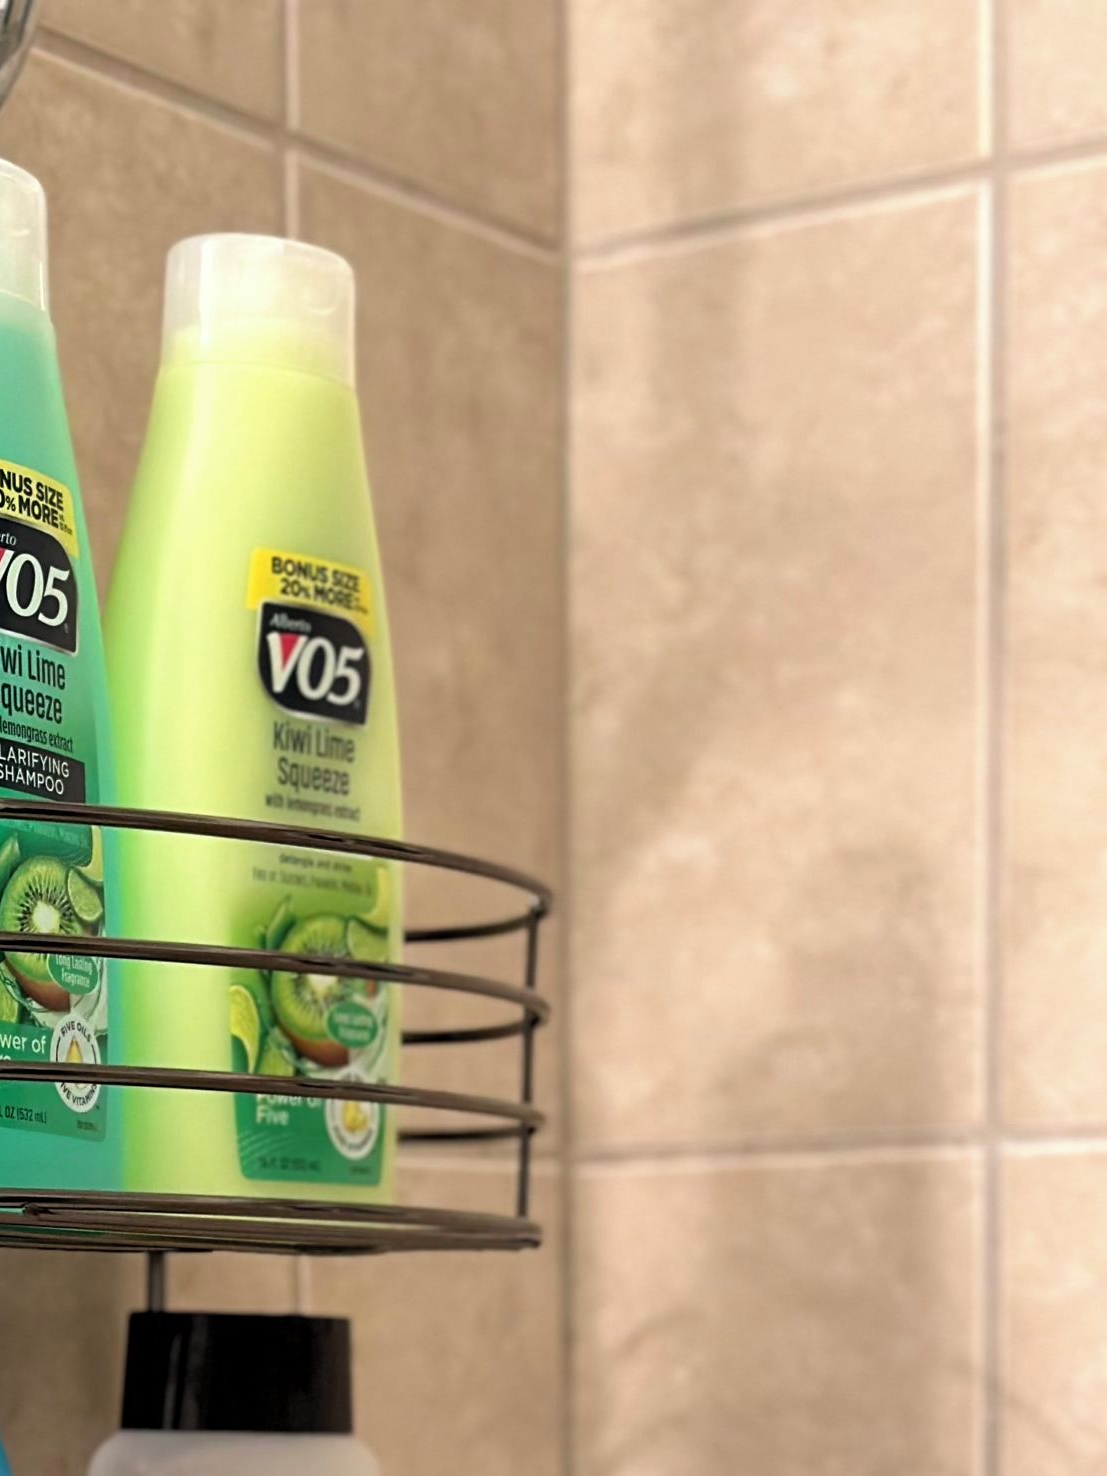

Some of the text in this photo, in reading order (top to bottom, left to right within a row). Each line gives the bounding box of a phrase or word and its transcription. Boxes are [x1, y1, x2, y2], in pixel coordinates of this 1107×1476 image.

[18, 495, 59, 529] MORE
[35, 480, 64, 511] SIZE
[271, 557, 360, 593] BONUS SIZE
[280, 578, 310, 600] 20%
[313, 586, 353, 611] MORE
[27, 650, 66, 690] Lime
[266, 631, 364, 706] VO5
[0, 715, 48, 747] lemongrass
[48, 734, 73, 753] extract
[273, 721, 355, 763] Kiwi Lime
[277, 757, 350, 796] Squeeze
[31, 1035, 47, 1054] of
[61, 1020, 92, 1043] FIVE OILS
